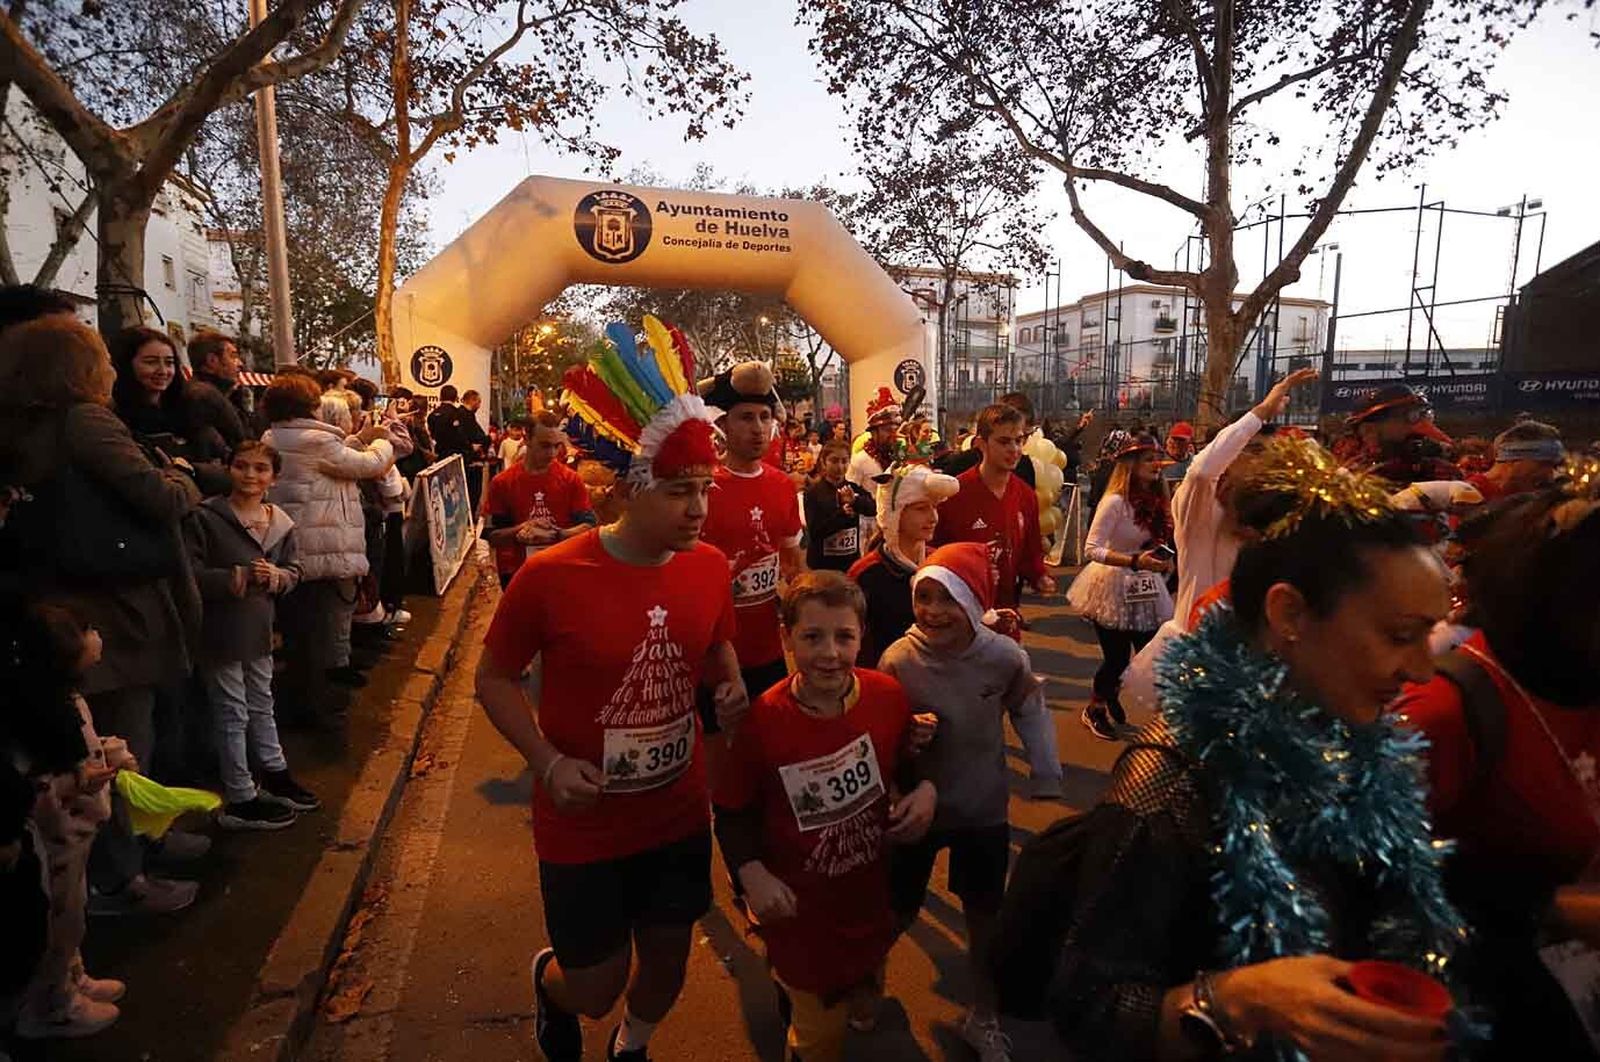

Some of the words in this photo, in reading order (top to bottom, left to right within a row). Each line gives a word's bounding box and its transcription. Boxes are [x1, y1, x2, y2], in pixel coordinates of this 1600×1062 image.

[656, 200, 789, 222] Ayuntamiento
[695, 218, 719, 234] de
[725, 220, 790, 238] Huelva
[725, 240, 739, 250] de
[742, 240, 792, 253] Deportes
[1432, 383, 1487, 394] HYUNDAI
[752, 568, 775, 592] 392
[646, 737, 687, 771] 390
[827, 761, 871, 801] 389
